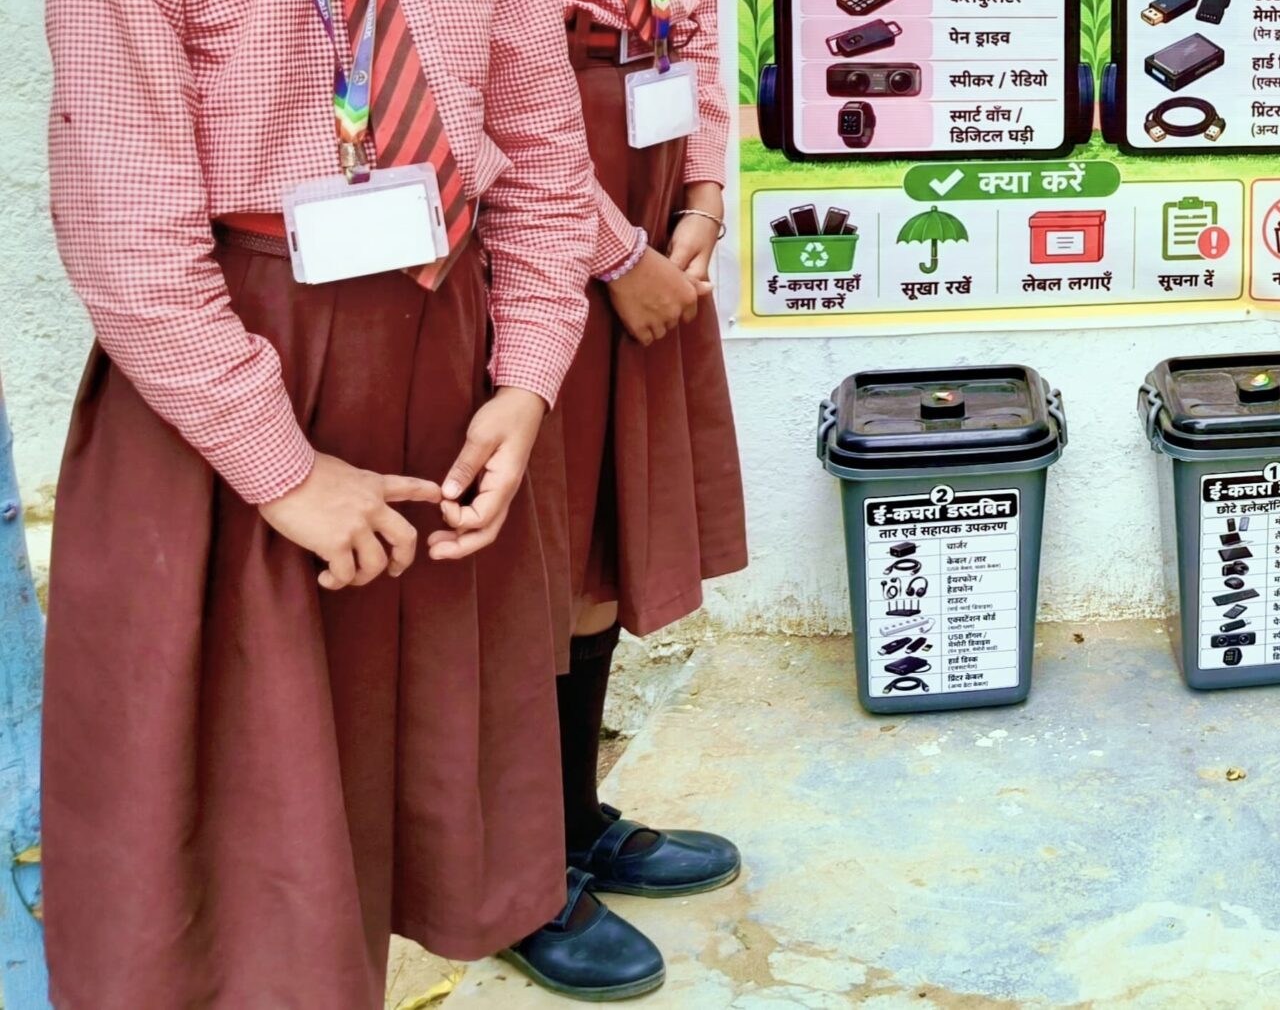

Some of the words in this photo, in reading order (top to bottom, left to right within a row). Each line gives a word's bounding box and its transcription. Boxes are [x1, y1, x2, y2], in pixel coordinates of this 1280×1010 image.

[949, 29, 971, 44] पेन
[976, 30, 1011, 47] ड्राइव
[1252, 53, 1274, 70] हार्ड
[950, 126, 1003, 143] डिजिटल
[1009, 126, 1034, 144] घड़ी
[979, 170, 1031, 193] क्या
[1040, 164, 1087, 193] करें
[767, 278, 830, 294] ई-कचरा
[834, 274, 861, 294] यहाँ
[901, 280, 939, 300] सूखा
[945, 276, 972, 295] रखें
[1022, 274, 1062, 292] लेबल
[1068, 272, 1113, 292] लगाएँ
[1158, 274, 1199, 290] सूचना
[1203, 271, 1214, 289] दें
[786, 296, 818, 311] जमा
[821, 294, 846, 311] करें
[1270, 466, 1278, 480] 1
[936, 489, 948, 502] 2
[1210, 482, 1273, 500] ई-कचरा
[873, 505, 941, 524] ई-कचरा
[1217, 500, 1237, 514] छोटे
[879, 528, 898, 539] तार
[901, 525, 918, 539] एवं
[921, 524, 961, 536] सहायक
[966, 521, 1007, 533] उपकरण
